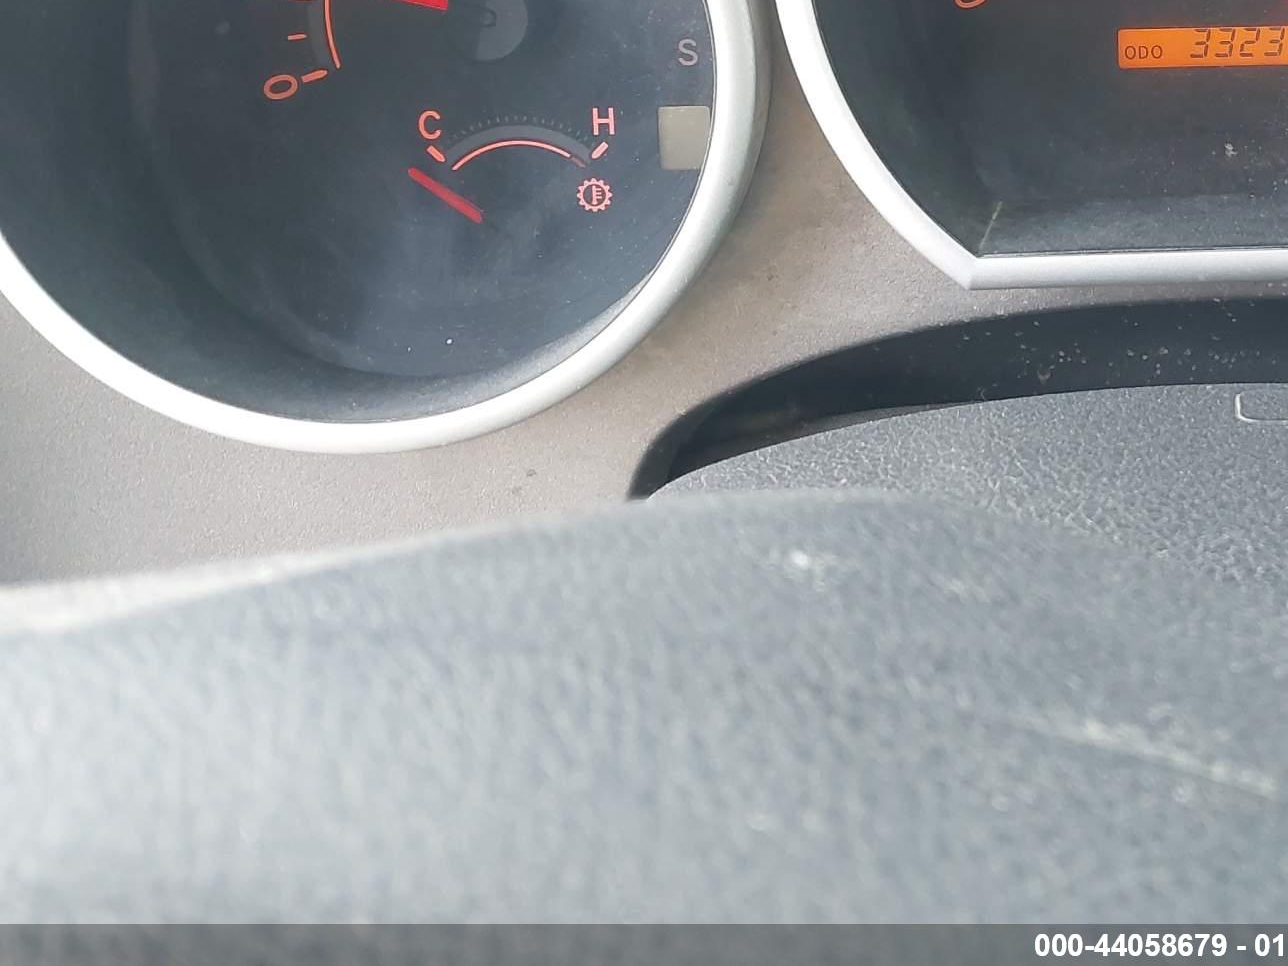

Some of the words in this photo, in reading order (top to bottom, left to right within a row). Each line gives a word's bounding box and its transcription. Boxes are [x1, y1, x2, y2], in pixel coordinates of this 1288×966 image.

[678, 39, 698, 66] S
[1124, 44, 1163, 60] ODO
[263, 73, 298, 100] 0
[418, 110, 441, 140] C
[592, 107, 615, 136] H
